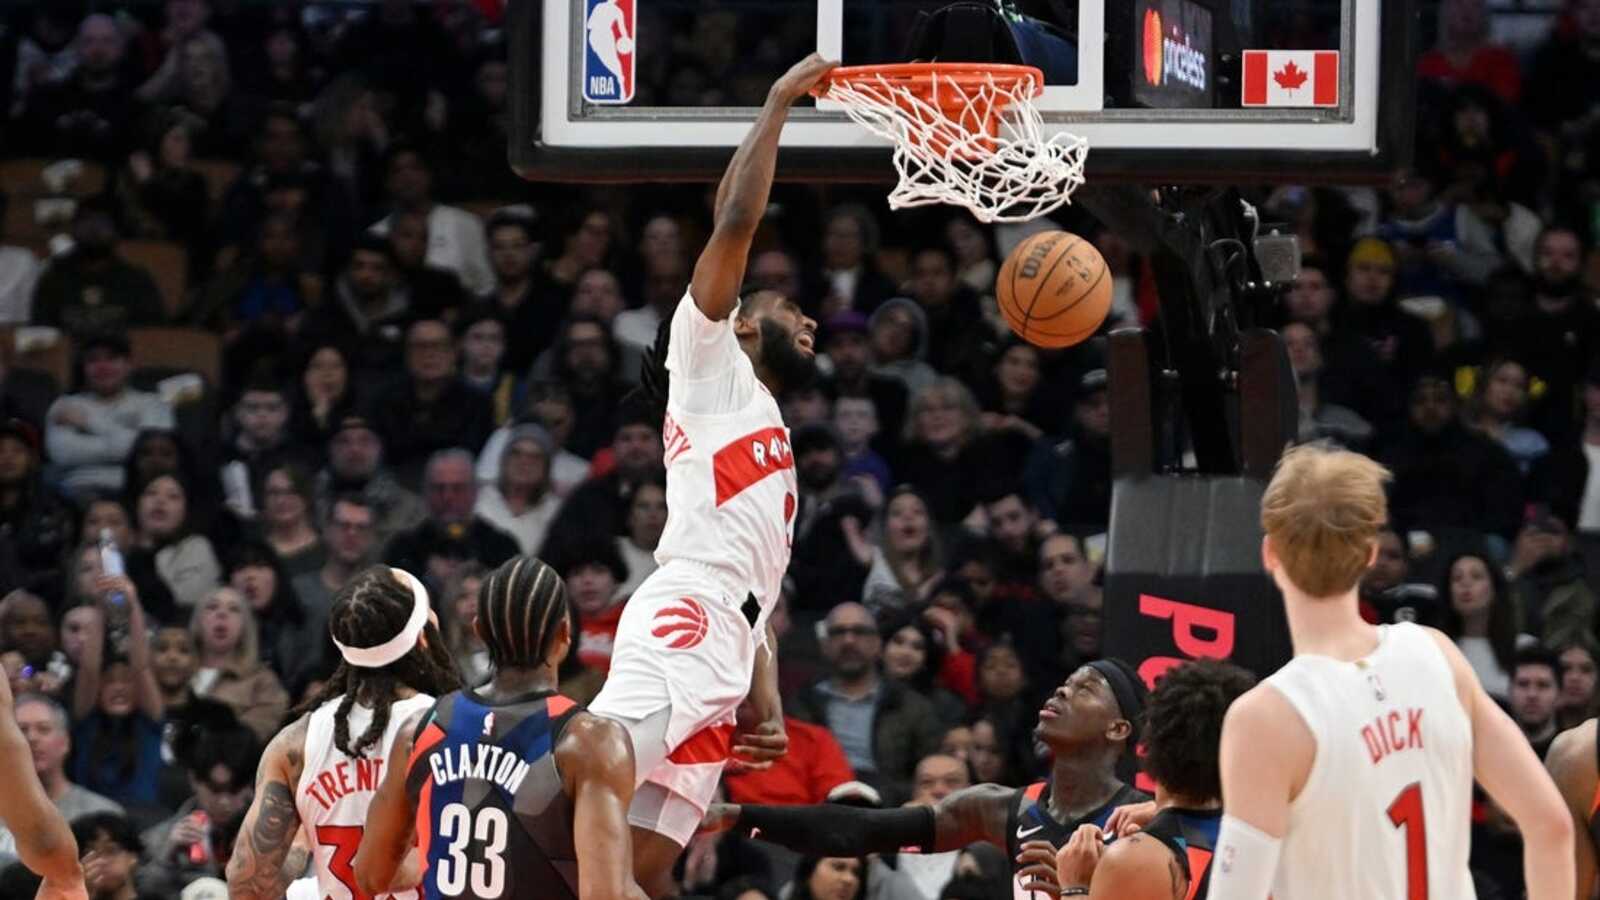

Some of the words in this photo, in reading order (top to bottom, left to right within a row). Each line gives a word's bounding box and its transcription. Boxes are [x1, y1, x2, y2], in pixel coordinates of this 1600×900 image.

[590, 75, 615, 96] NBA
[1163, 25, 1205, 90] priceless
[1361, 707, 1424, 765] DICK
[305, 757, 384, 811] TRENT
[429, 743, 531, 796] CLAXTON
[436, 802, 508, 899] 33
[1386, 780, 1428, 900] 1
